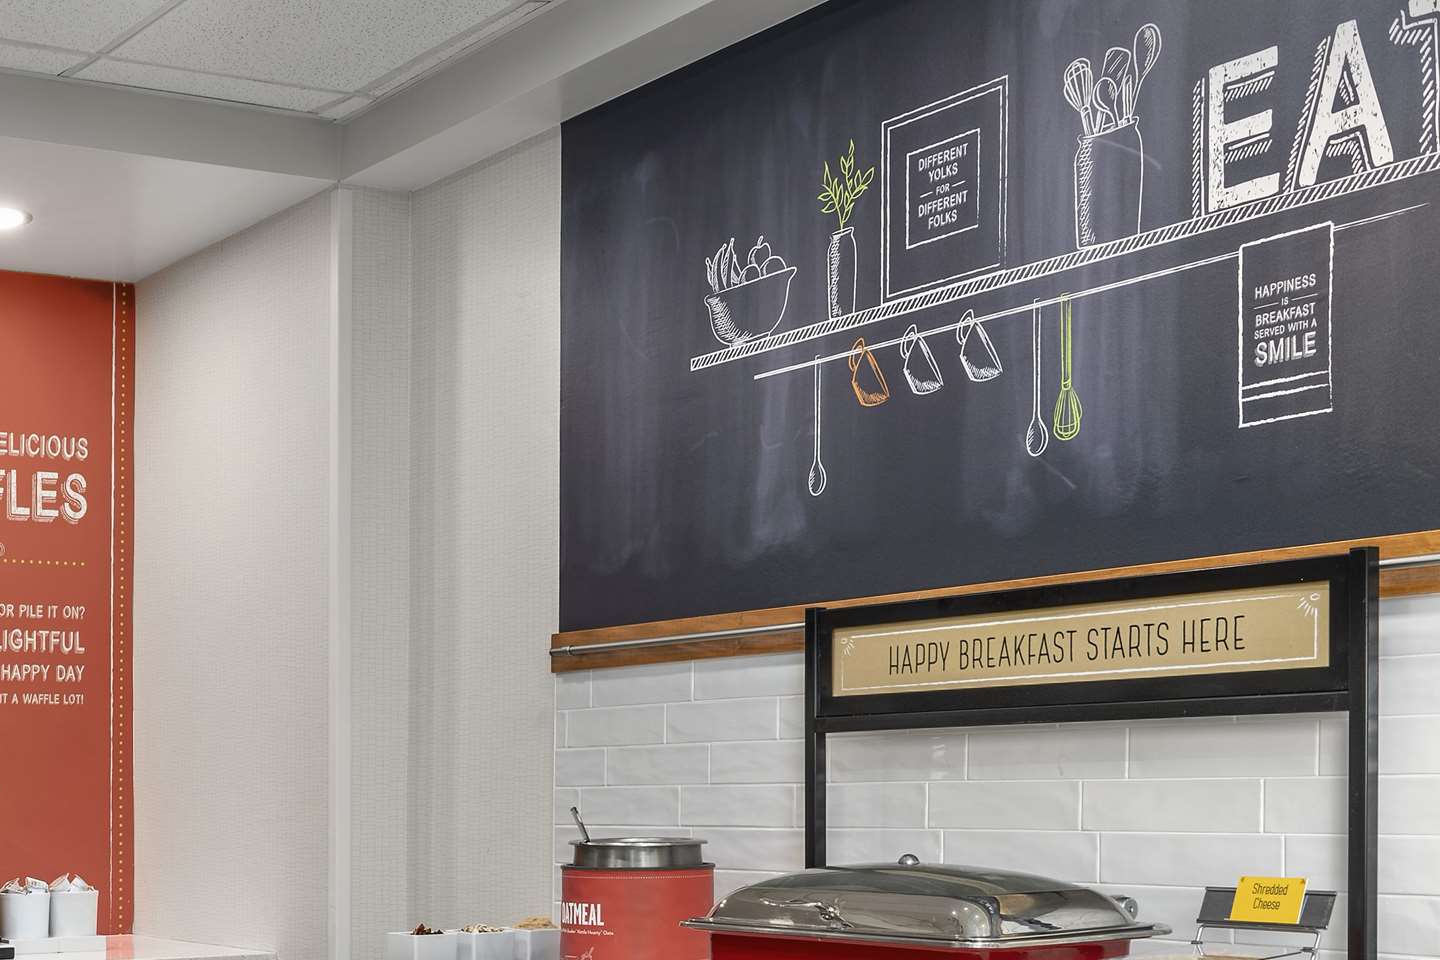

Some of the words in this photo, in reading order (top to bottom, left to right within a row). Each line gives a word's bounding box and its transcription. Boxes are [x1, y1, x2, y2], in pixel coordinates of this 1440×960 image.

[1193, 0, 1440, 219] EA
[919, 143, 968, 172] DIFFERENT
[928, 162, 958, 183] YOLKS
[936, 183, 950, 196] FOR
[918, 190, 968, 218] DIFFERENT
[928, 209, 957, 230] FOLKS
[1255, 273, 1316, 300] HAPPINESS
[1281, 297, 1289, 306] IS
[1255, 303, 1316, 327] BREAKFAST
[1254, 325, 1285, 340] SERVED
[1288, 320, 1308, 333] WITH
[1310, 318, 1318, 328] A
[1254, 331, 1317, 367] SMILE
[19, 604, 43, 619] PILE
[48, 605, 58, 619] IT
[63, 606, 85, 619] ON?
[888, 641, 951, 676] HAPPY
[959, 630, 1078, 670] BREAKFAST
[1086, 622, 1169, 660] STARTS
[1182, 615, 1247, 653] HERE
[1, 664, 50, 681] HAPPY
[56, 665, 85, 682] DAY
[0, 693, 8, 704] IT
[11, 693, 19, 704] A
[23, 693, 60, 705] WAFFLE
[63, 694, 84, 705] LOT!
[1252, 883, 1288, 896] Shredded
[1253, 897, 1280, 910] Cheese
